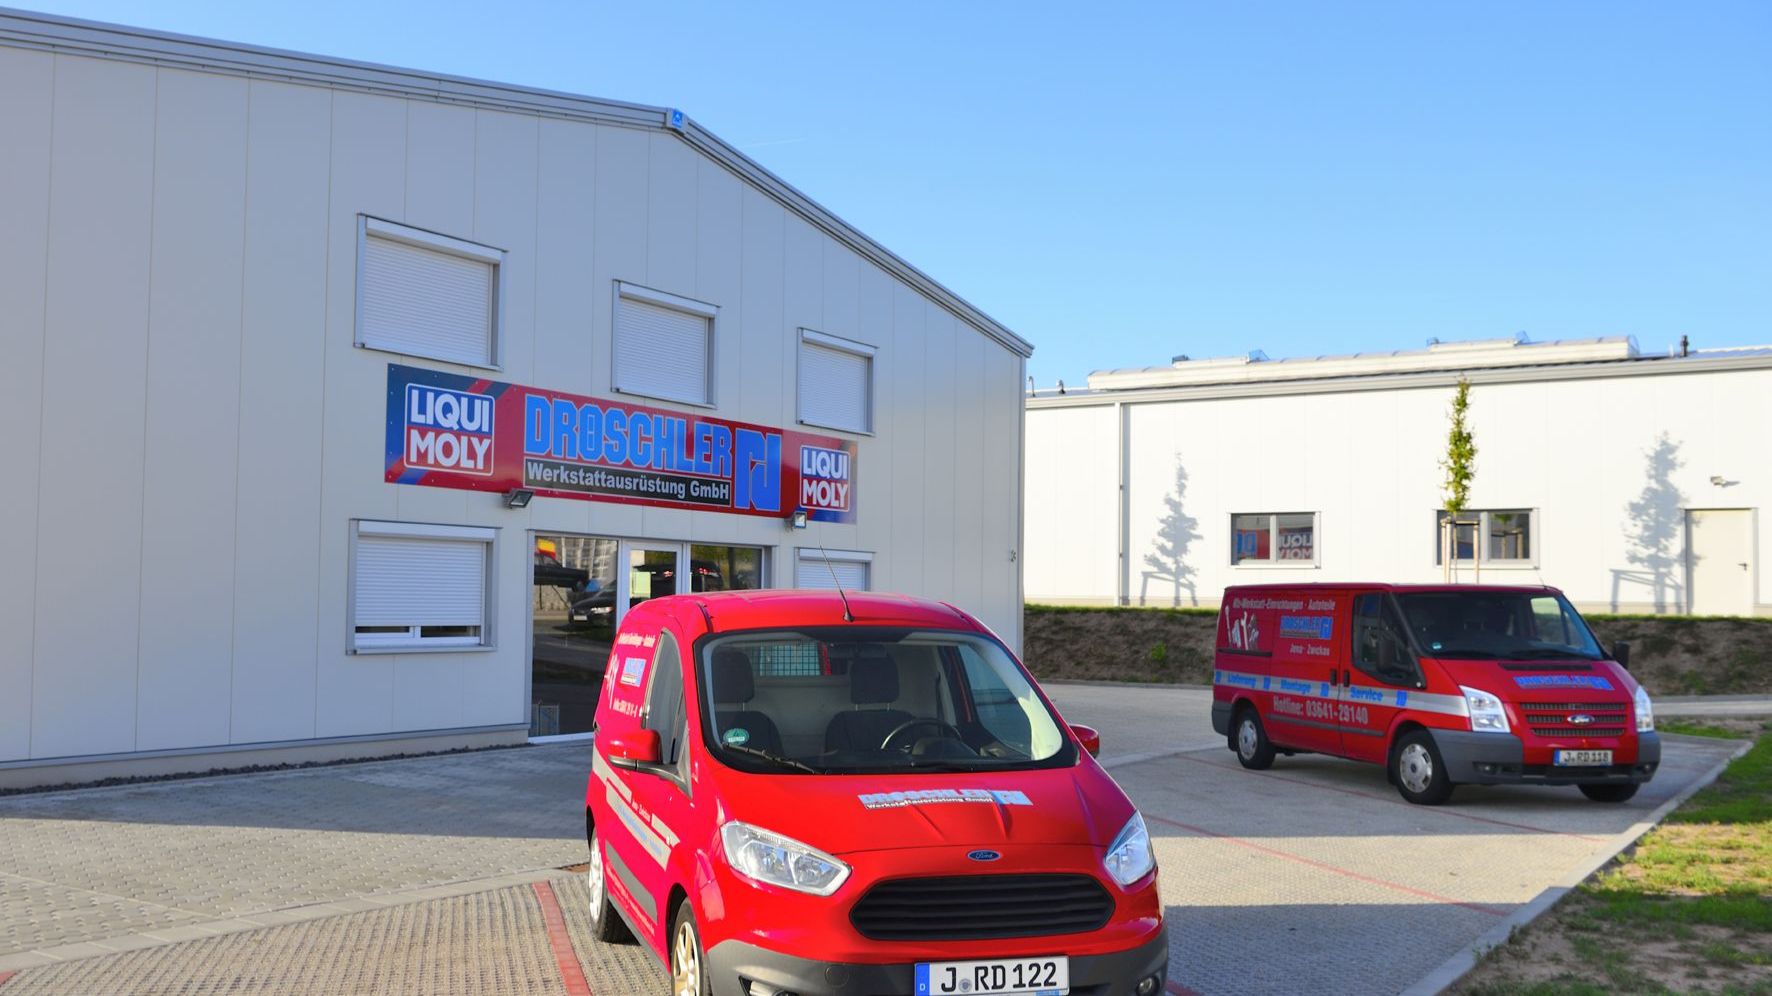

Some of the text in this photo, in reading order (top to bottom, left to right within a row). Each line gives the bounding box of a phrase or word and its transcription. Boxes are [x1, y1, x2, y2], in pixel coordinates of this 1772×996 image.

[411, 389, 489, 432] LIQUI
[410, 429, 491, 470] MOLY
[803, 449, 847, 479] LIQUI
[527, 461, 730, 500] Werkstattausrüstung GmbH
[803, 479, 848, 507] MOLY
[1350, 687, 1383, 701] Service
[1273, 697, 1368, 724] Hotline: 03641-29140
[919, 962, 1057, 992] D J RD 122
